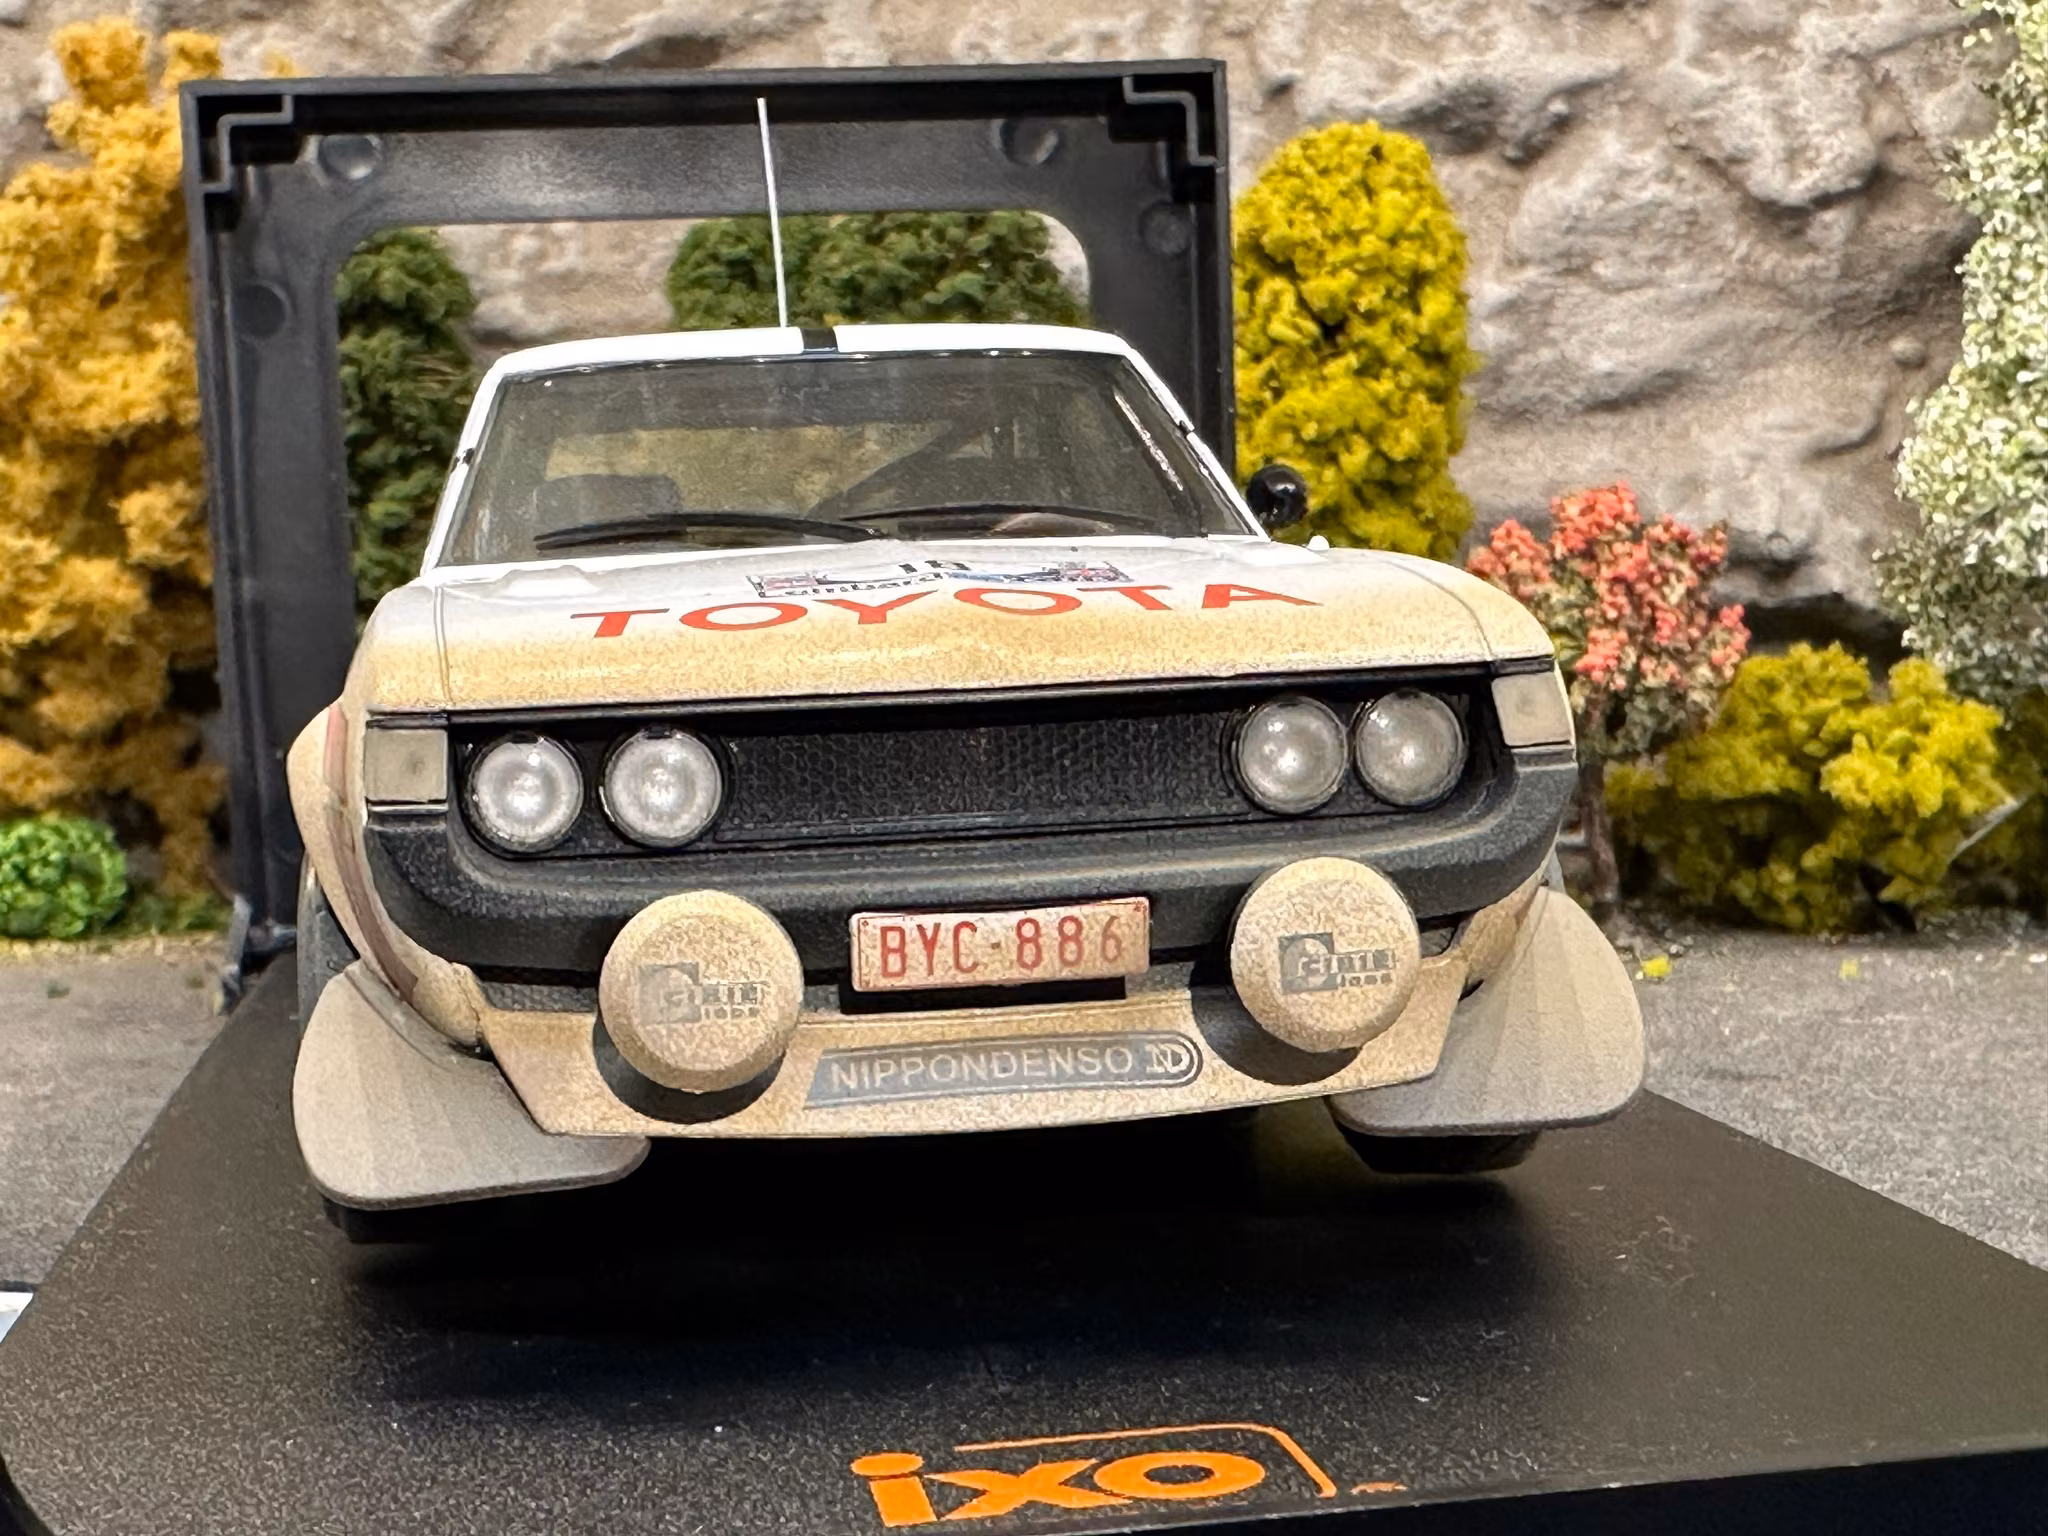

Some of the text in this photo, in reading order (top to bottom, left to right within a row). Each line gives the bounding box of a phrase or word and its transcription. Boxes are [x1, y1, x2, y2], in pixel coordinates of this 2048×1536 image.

[571, 583, 1321, 638] TOYOTA
[880, 915, 1122, 978] BYC-886
[831, 1046, 1133, 1092] NIPPONDENSO
[850, 1451, 1266, 1527] ixo
